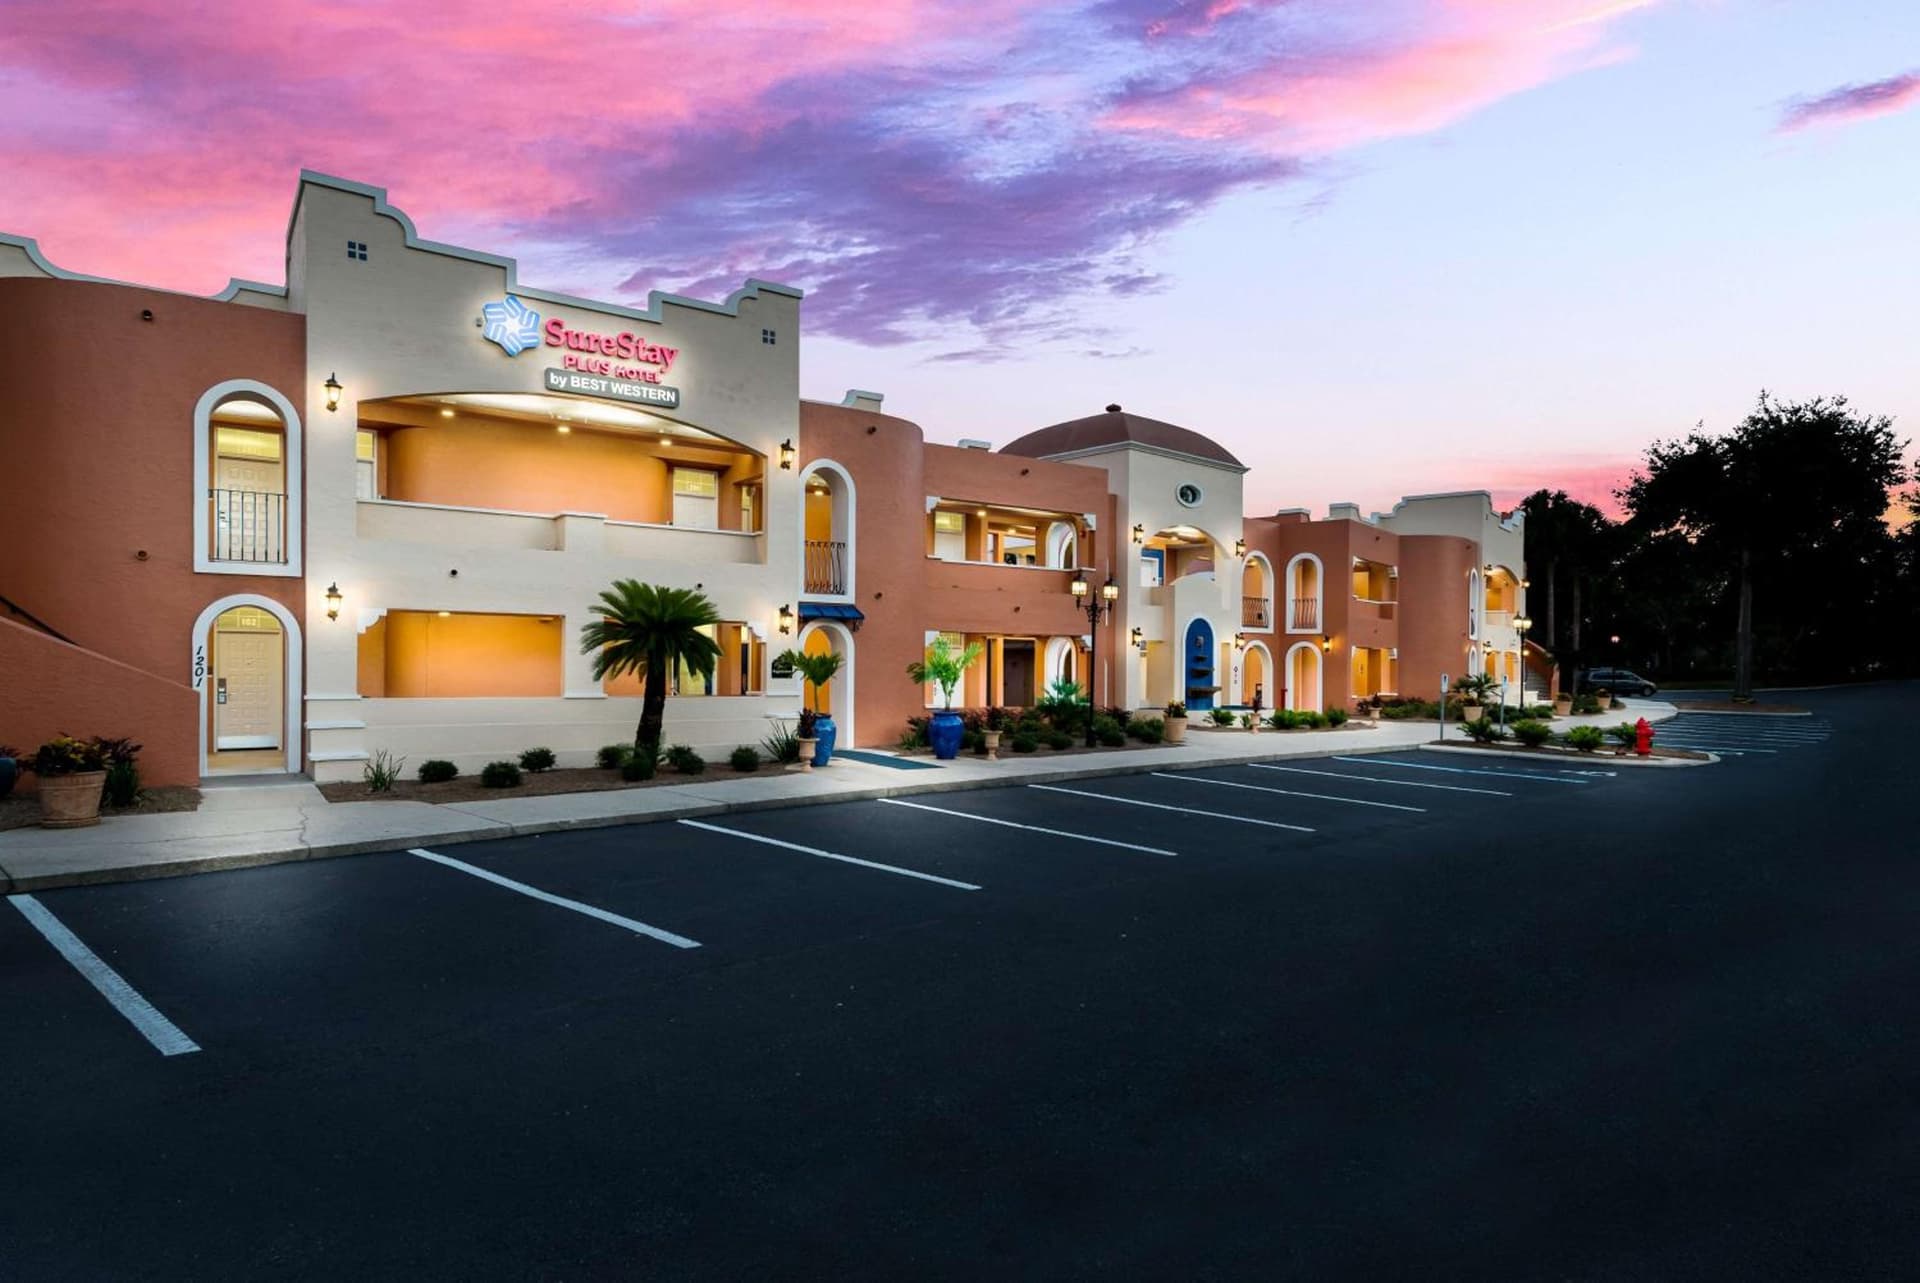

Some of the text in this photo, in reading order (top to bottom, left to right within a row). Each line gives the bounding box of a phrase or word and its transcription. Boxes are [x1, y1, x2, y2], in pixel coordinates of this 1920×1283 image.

[545, 319, 679, 371] SureStay
[549, 372, 676, 402] by BEST WESTERN
[564, 354, 662, 384] PLUS HOTEL
[195, 645, 205, 687] 1201
